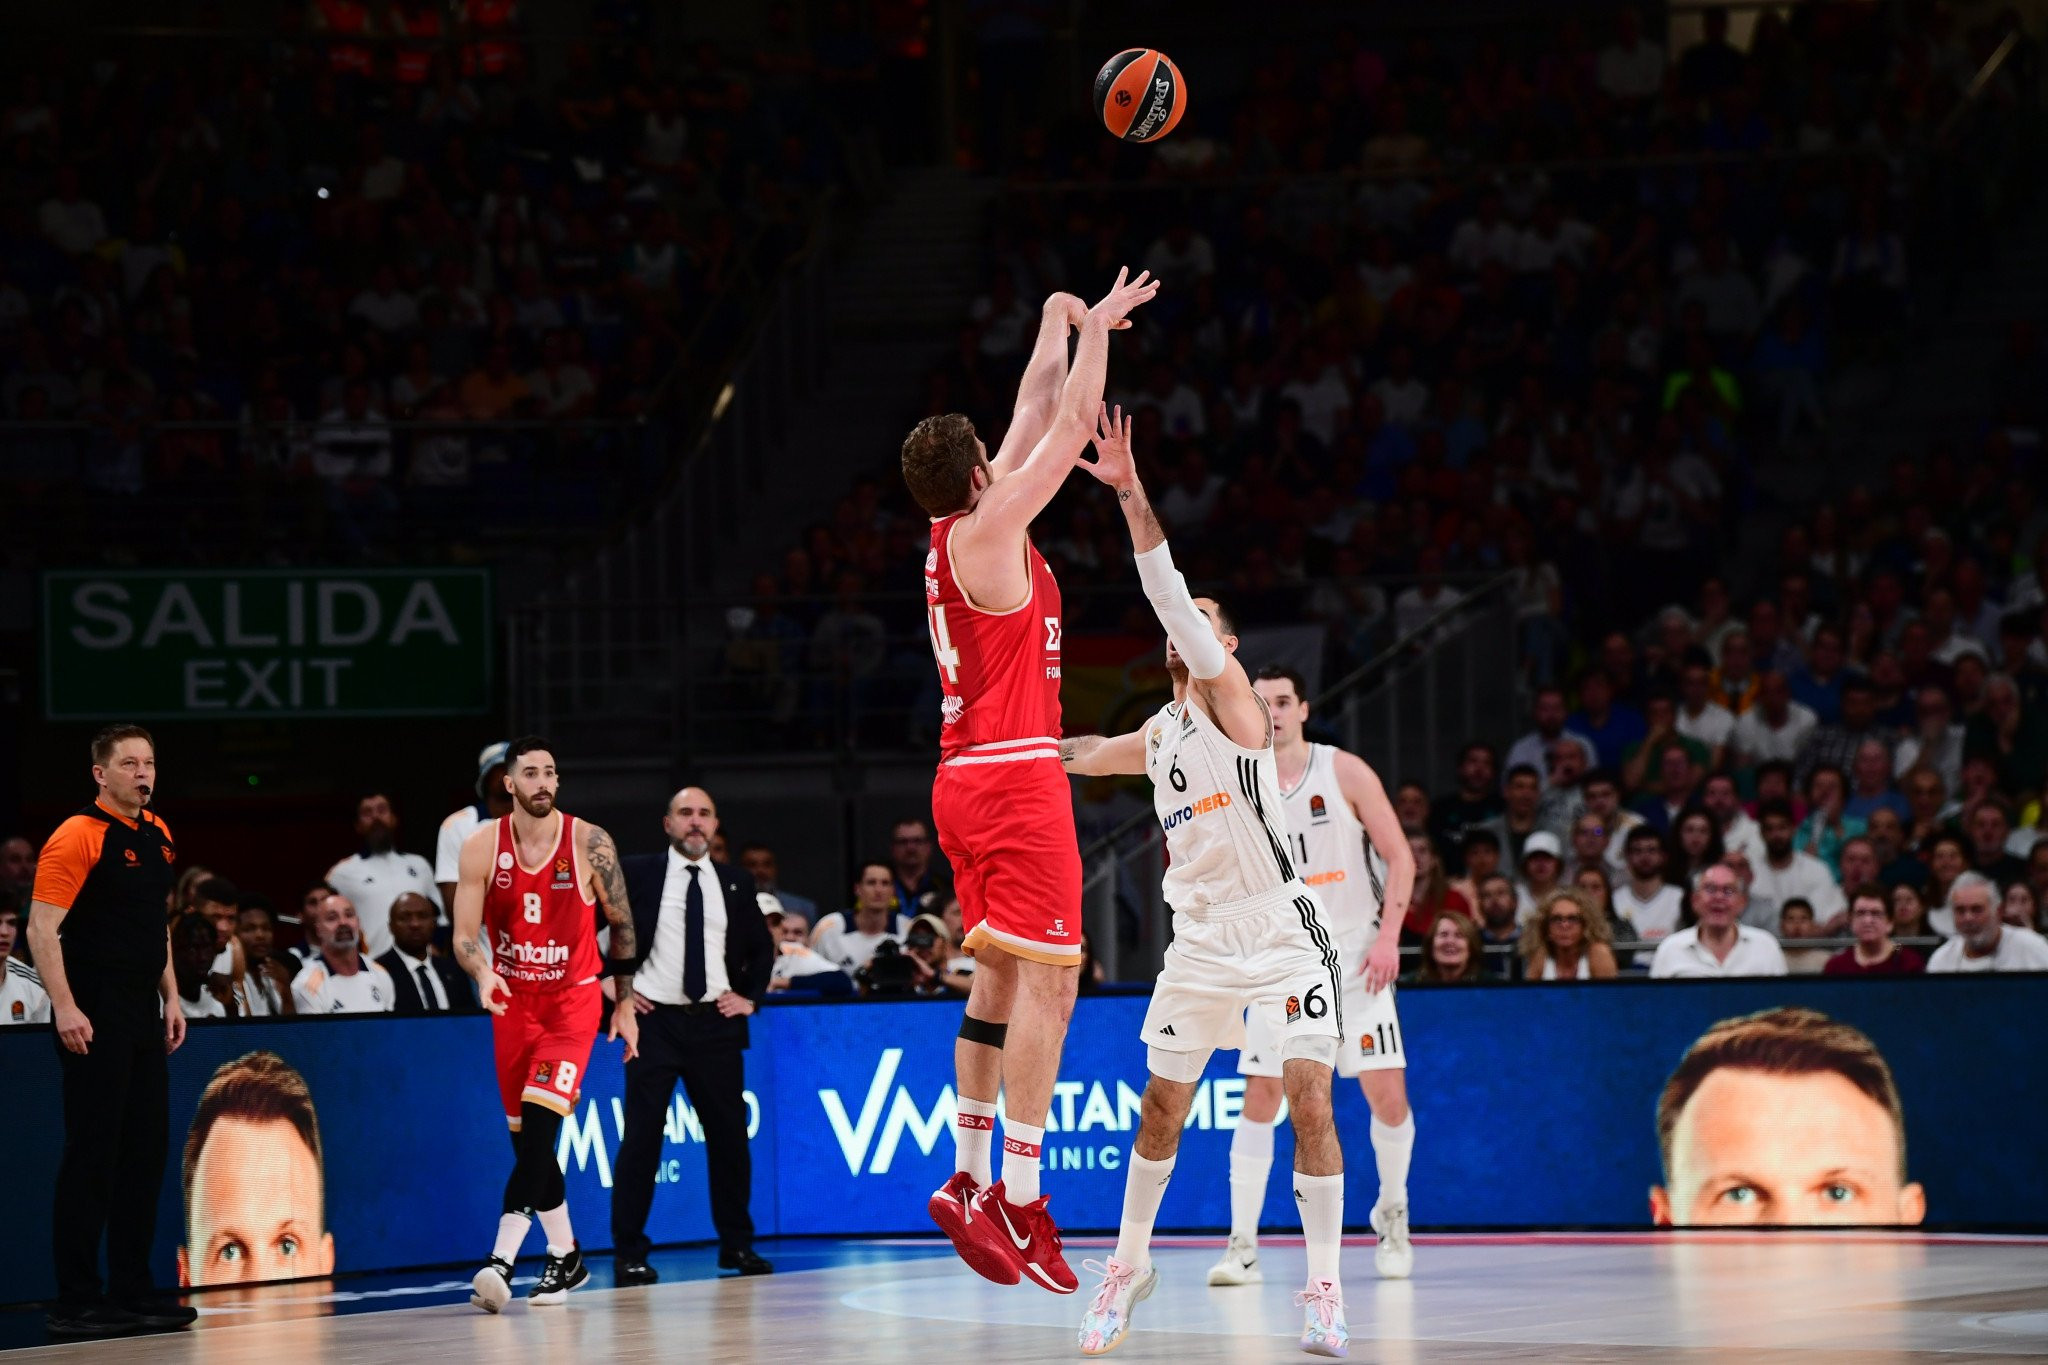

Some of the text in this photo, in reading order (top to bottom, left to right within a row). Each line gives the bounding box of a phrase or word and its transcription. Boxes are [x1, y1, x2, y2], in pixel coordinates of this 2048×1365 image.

[70, 580, 460, 650] SALIDA
[927, 603, 961, 685] 4
[184, 658, 353, 708] EXIT
[1168, 754, 1187, 793] 6
[523, 892, 542, 925] 8
[1303, 983, 1328, 1019] 6
[1376, 1022, 1397, 1055] 11
[554, 1060, 578, 1093] 8
